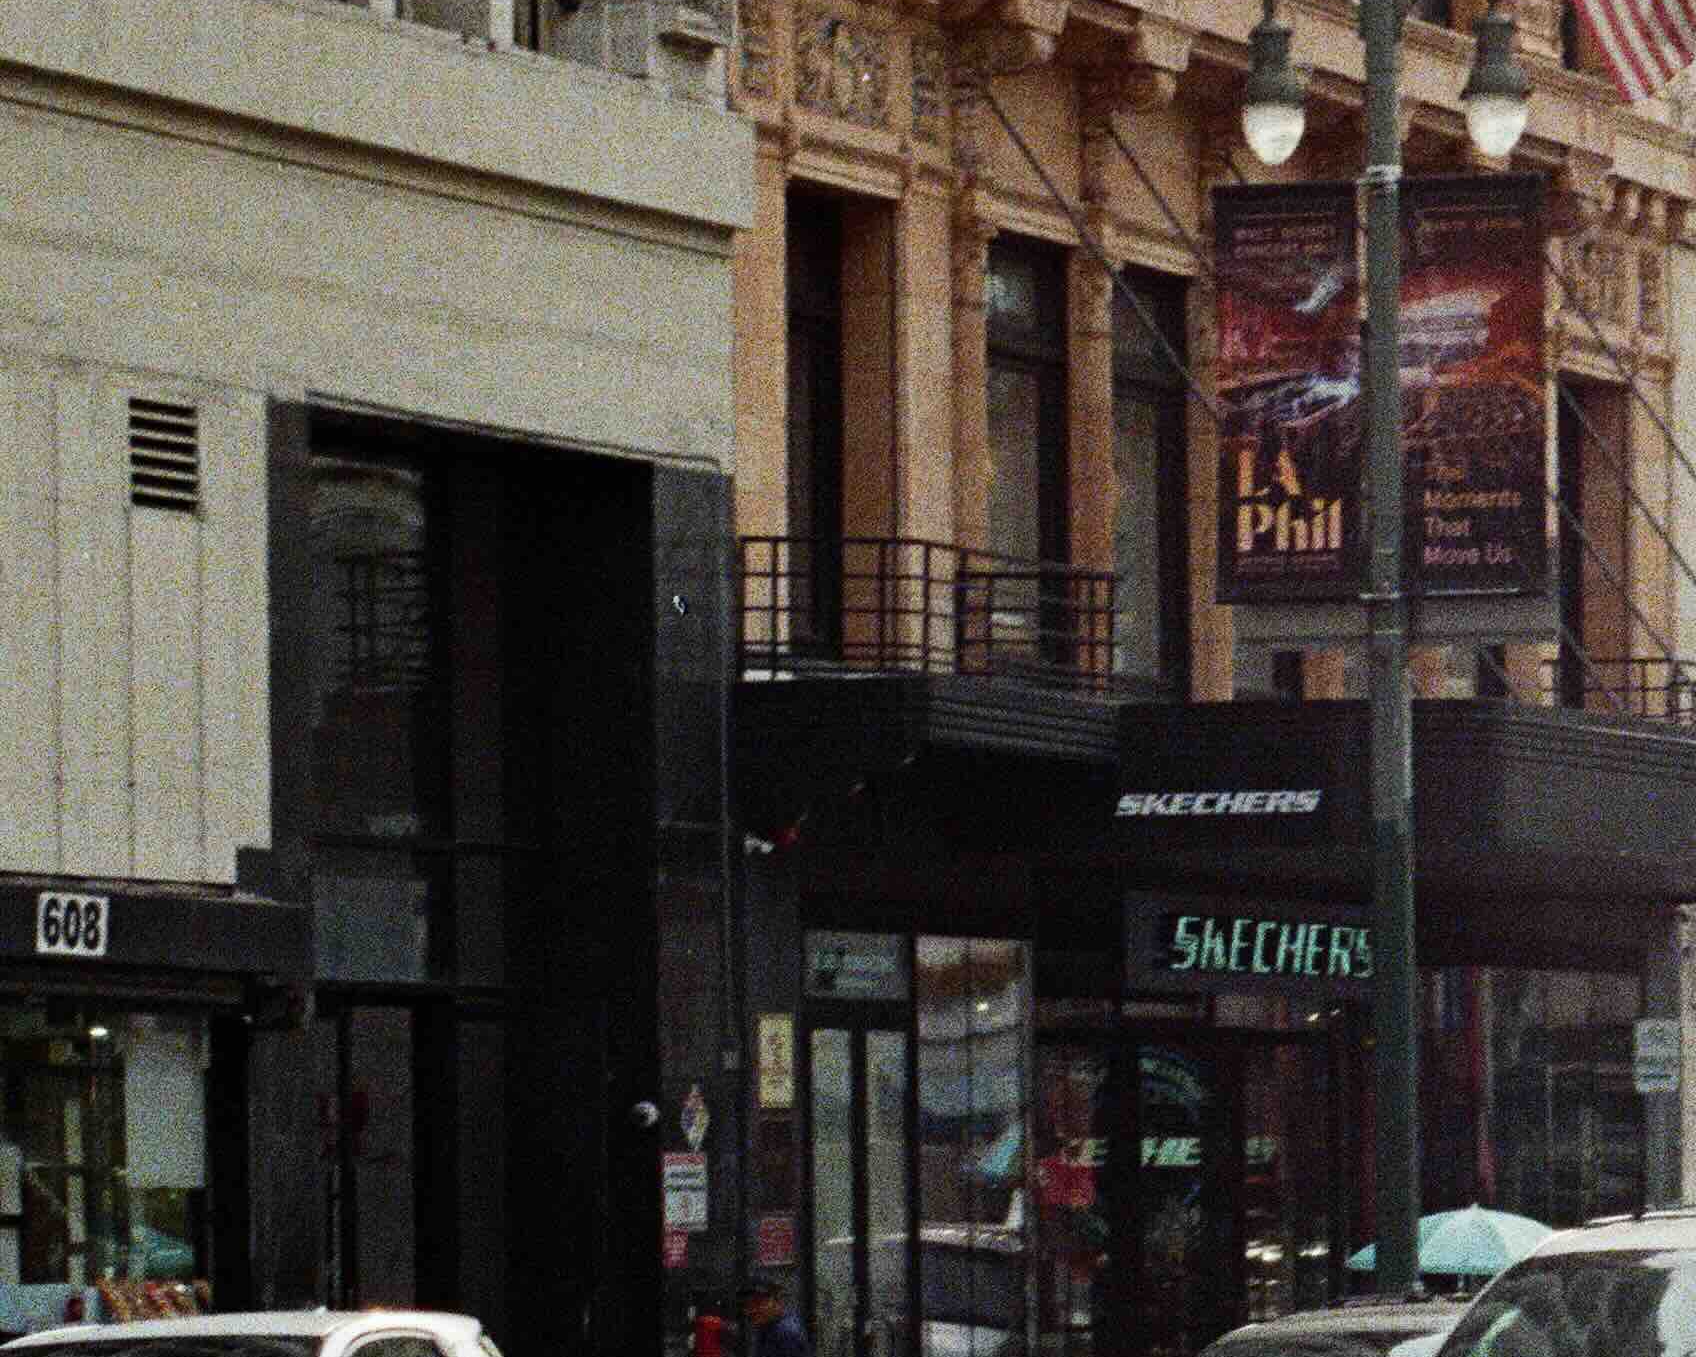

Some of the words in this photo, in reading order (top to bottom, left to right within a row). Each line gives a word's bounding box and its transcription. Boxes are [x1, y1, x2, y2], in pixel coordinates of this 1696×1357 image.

[1235, 445, 1302, 499] LA
[1235, 498, 1345, 552] Phil
[1424, 516, 1473, 539] That
[1423, 545, 1481, 567] Move
[1115, 789, 1322, 817] SKECHERS
[42, 897, 102, 950] 608
[1171, 915, 1375, 978] SKECHERS
